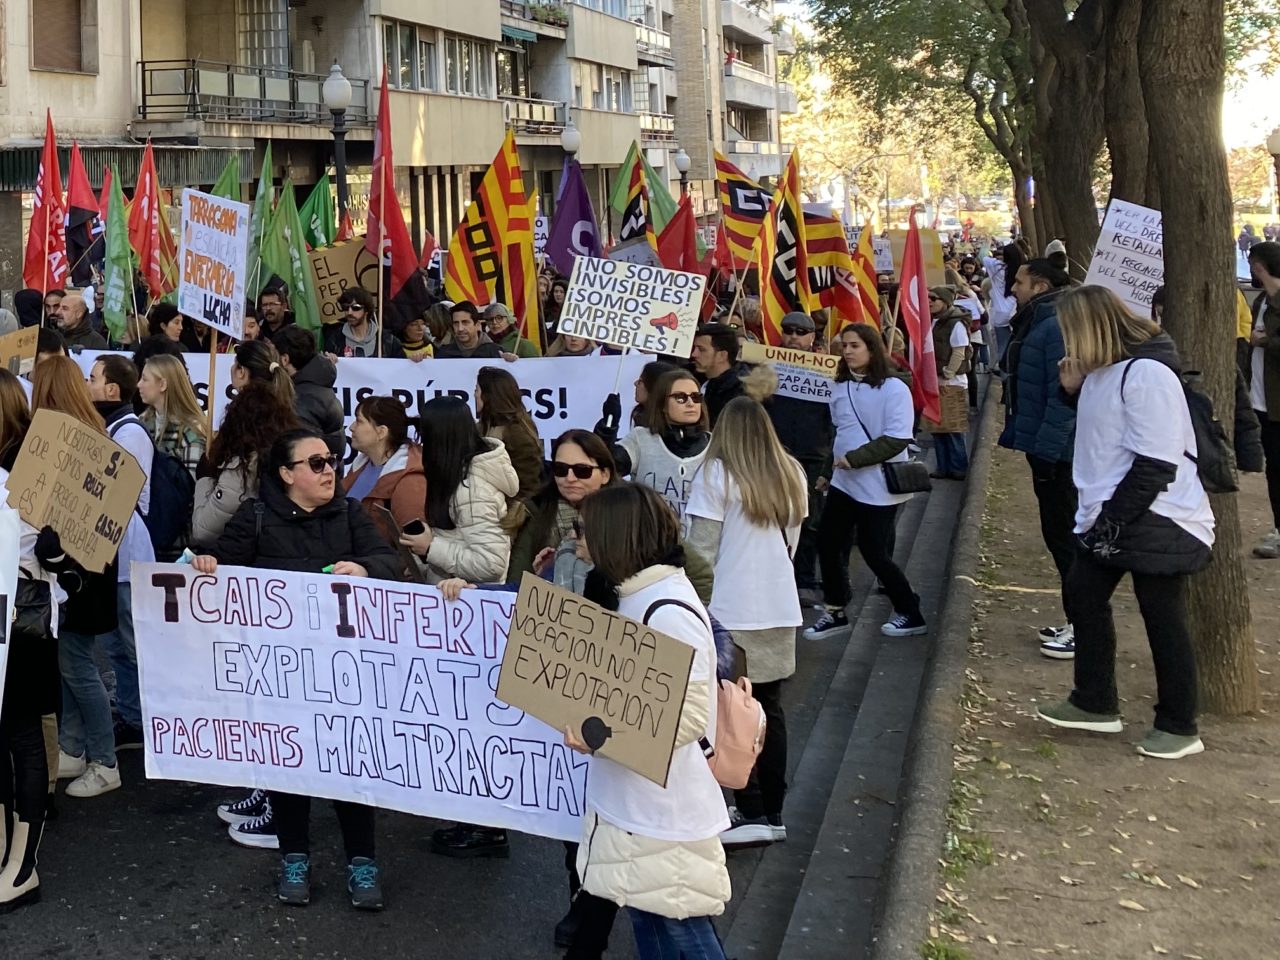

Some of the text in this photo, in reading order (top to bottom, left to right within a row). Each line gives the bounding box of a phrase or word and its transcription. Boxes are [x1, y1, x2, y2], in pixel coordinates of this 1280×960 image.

[189, 194, 237, 236] TARRAGONA
[1112, 232, 1162, 258] RETALLA
[1141, 227, 1162, 242] DRE
[184, 249, 235, 299] ENFERMERÍA
[312, 256, 339, 280] EL
[625, 264, 701, 291] SOMOS
[1121, 256, 1162, 278] RECONEI
[319, 278, 348, 299] PER
[574, 270, 692, 307] INVISIBLES!
[1120, 271, 1161, 293] SOLAPA
[1131, 288, 1153, 305] HOR
[203, 293, 231, 326] LUCHA
[322, 302, 346, 317] QU
[567, 287, 651, 315] ¡SOMOS
[566, 302, 642, 331] IMPRES
[765, 348, 836, 369] UNIM-NO
[791, 384, 832, 398] GENER
[803, 378, 811, 386] A
[815, 380, 829, 389] LA
[54, 450, 84, 481] SOMOS
[82, 472, 107, 501] ROLEX
[104, 451, 125, 480] SÍ
[35, 473, 47, 491] A
[51, 482, 78, 514] PRECIO
[42, 502, 61, 531] UNA
[151, 573, 516, 659] TCAIS i INFERM
[527, 586, 657, 662] NUESTRA
[513, 608, 673, 703] VOCACION NO ES
[213, 641, 527, 727] EXPLOTATS
[514, 644, 665, 738] EXPLOTACION
[151, 715, 304, 769] PACIENTS
